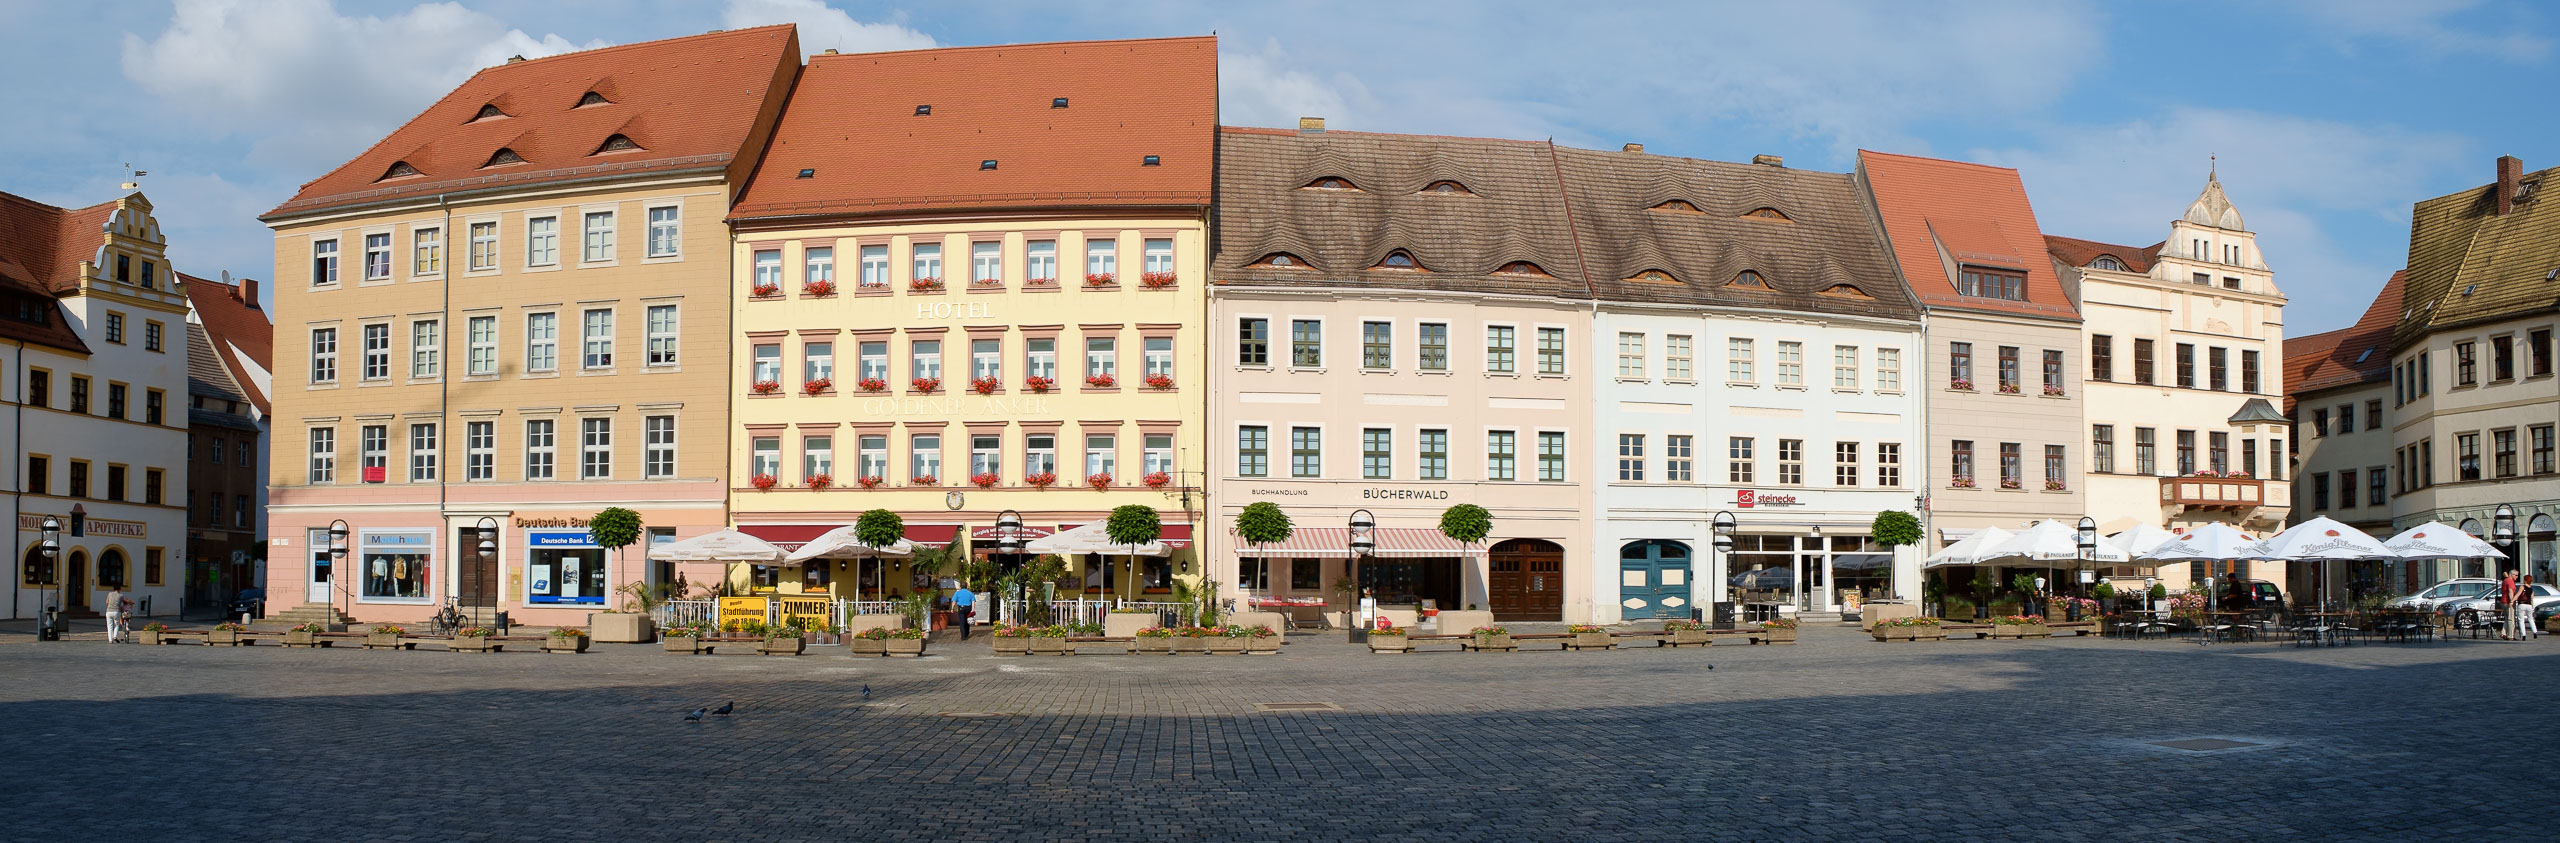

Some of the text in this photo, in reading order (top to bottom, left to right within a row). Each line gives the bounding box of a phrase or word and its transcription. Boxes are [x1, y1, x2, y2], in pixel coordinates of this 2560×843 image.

[917, 302, 996, 319] HOTEL
[864, 398, 1051, 416] GOLDENER ANKER
[1363, 487, 1449, 500] BÜCHERWALD
[1758, 493, 1796, 504] steinecke
[19, 516, 67, 531] MOHN-
[516, 517, 593, 528] Deutsche Ban
[541, 537, 584, 545] Deutsche Bank
[2301, 538, 2373, 554] König Pilsener
[722, 607, 764, 616] Stadtführung
[784, 601, 826, 614] ZIMMER
